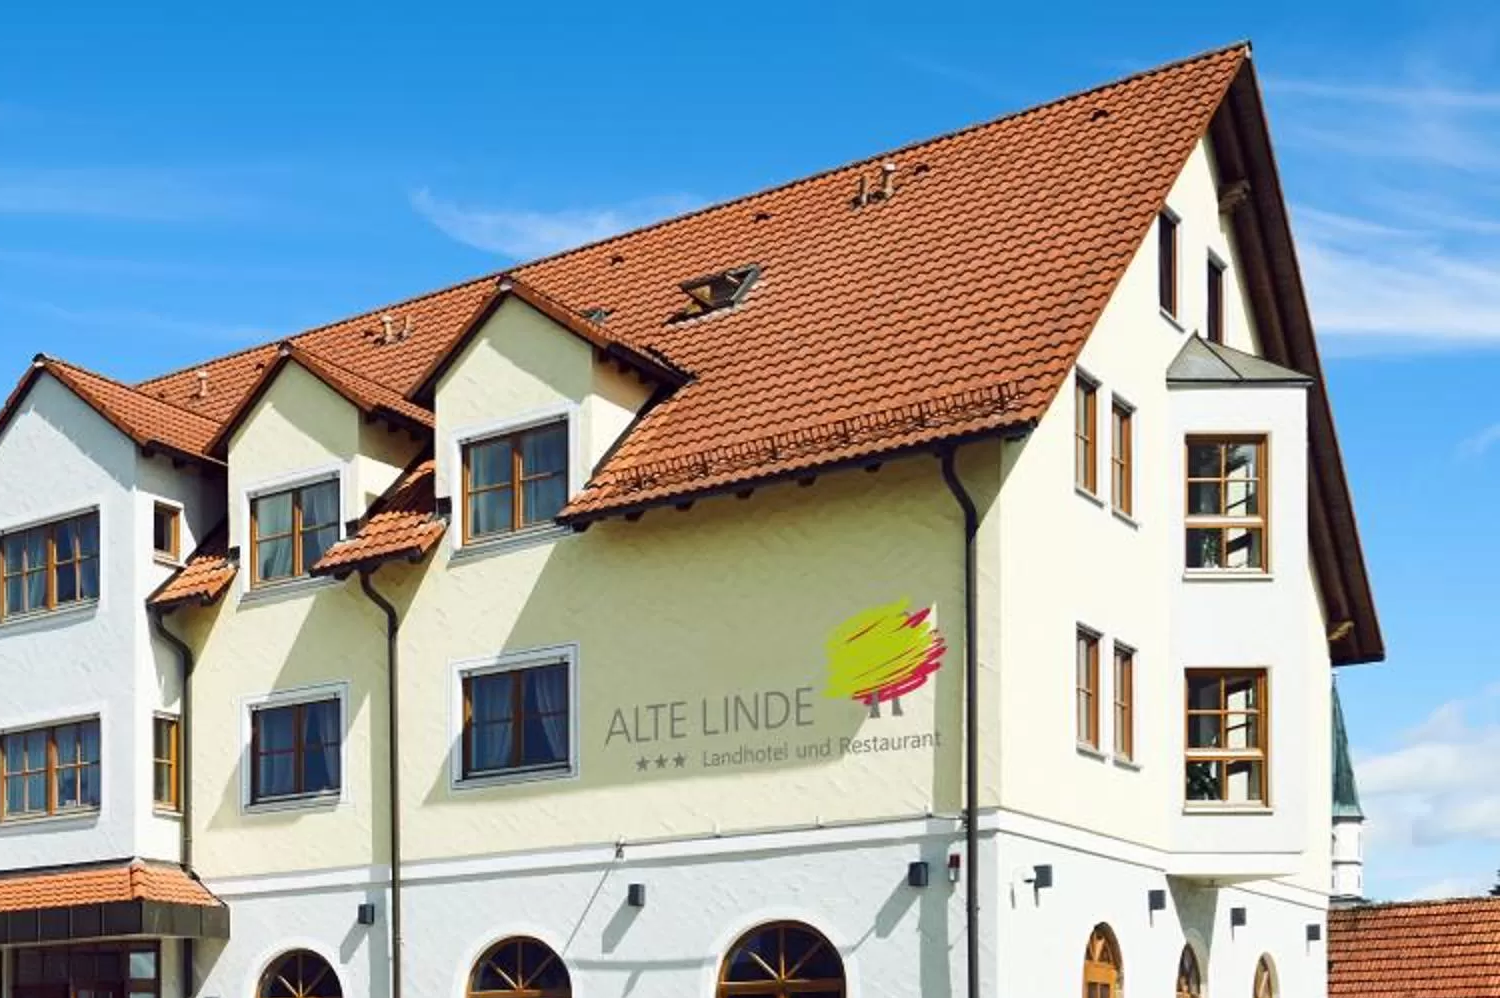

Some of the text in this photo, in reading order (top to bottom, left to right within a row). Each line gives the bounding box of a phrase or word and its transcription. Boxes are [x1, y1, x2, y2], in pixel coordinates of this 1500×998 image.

[604, 687, 814, 745] ALTE LINDE
[703, 731, 942, 768] Landhotel und Restaurant
